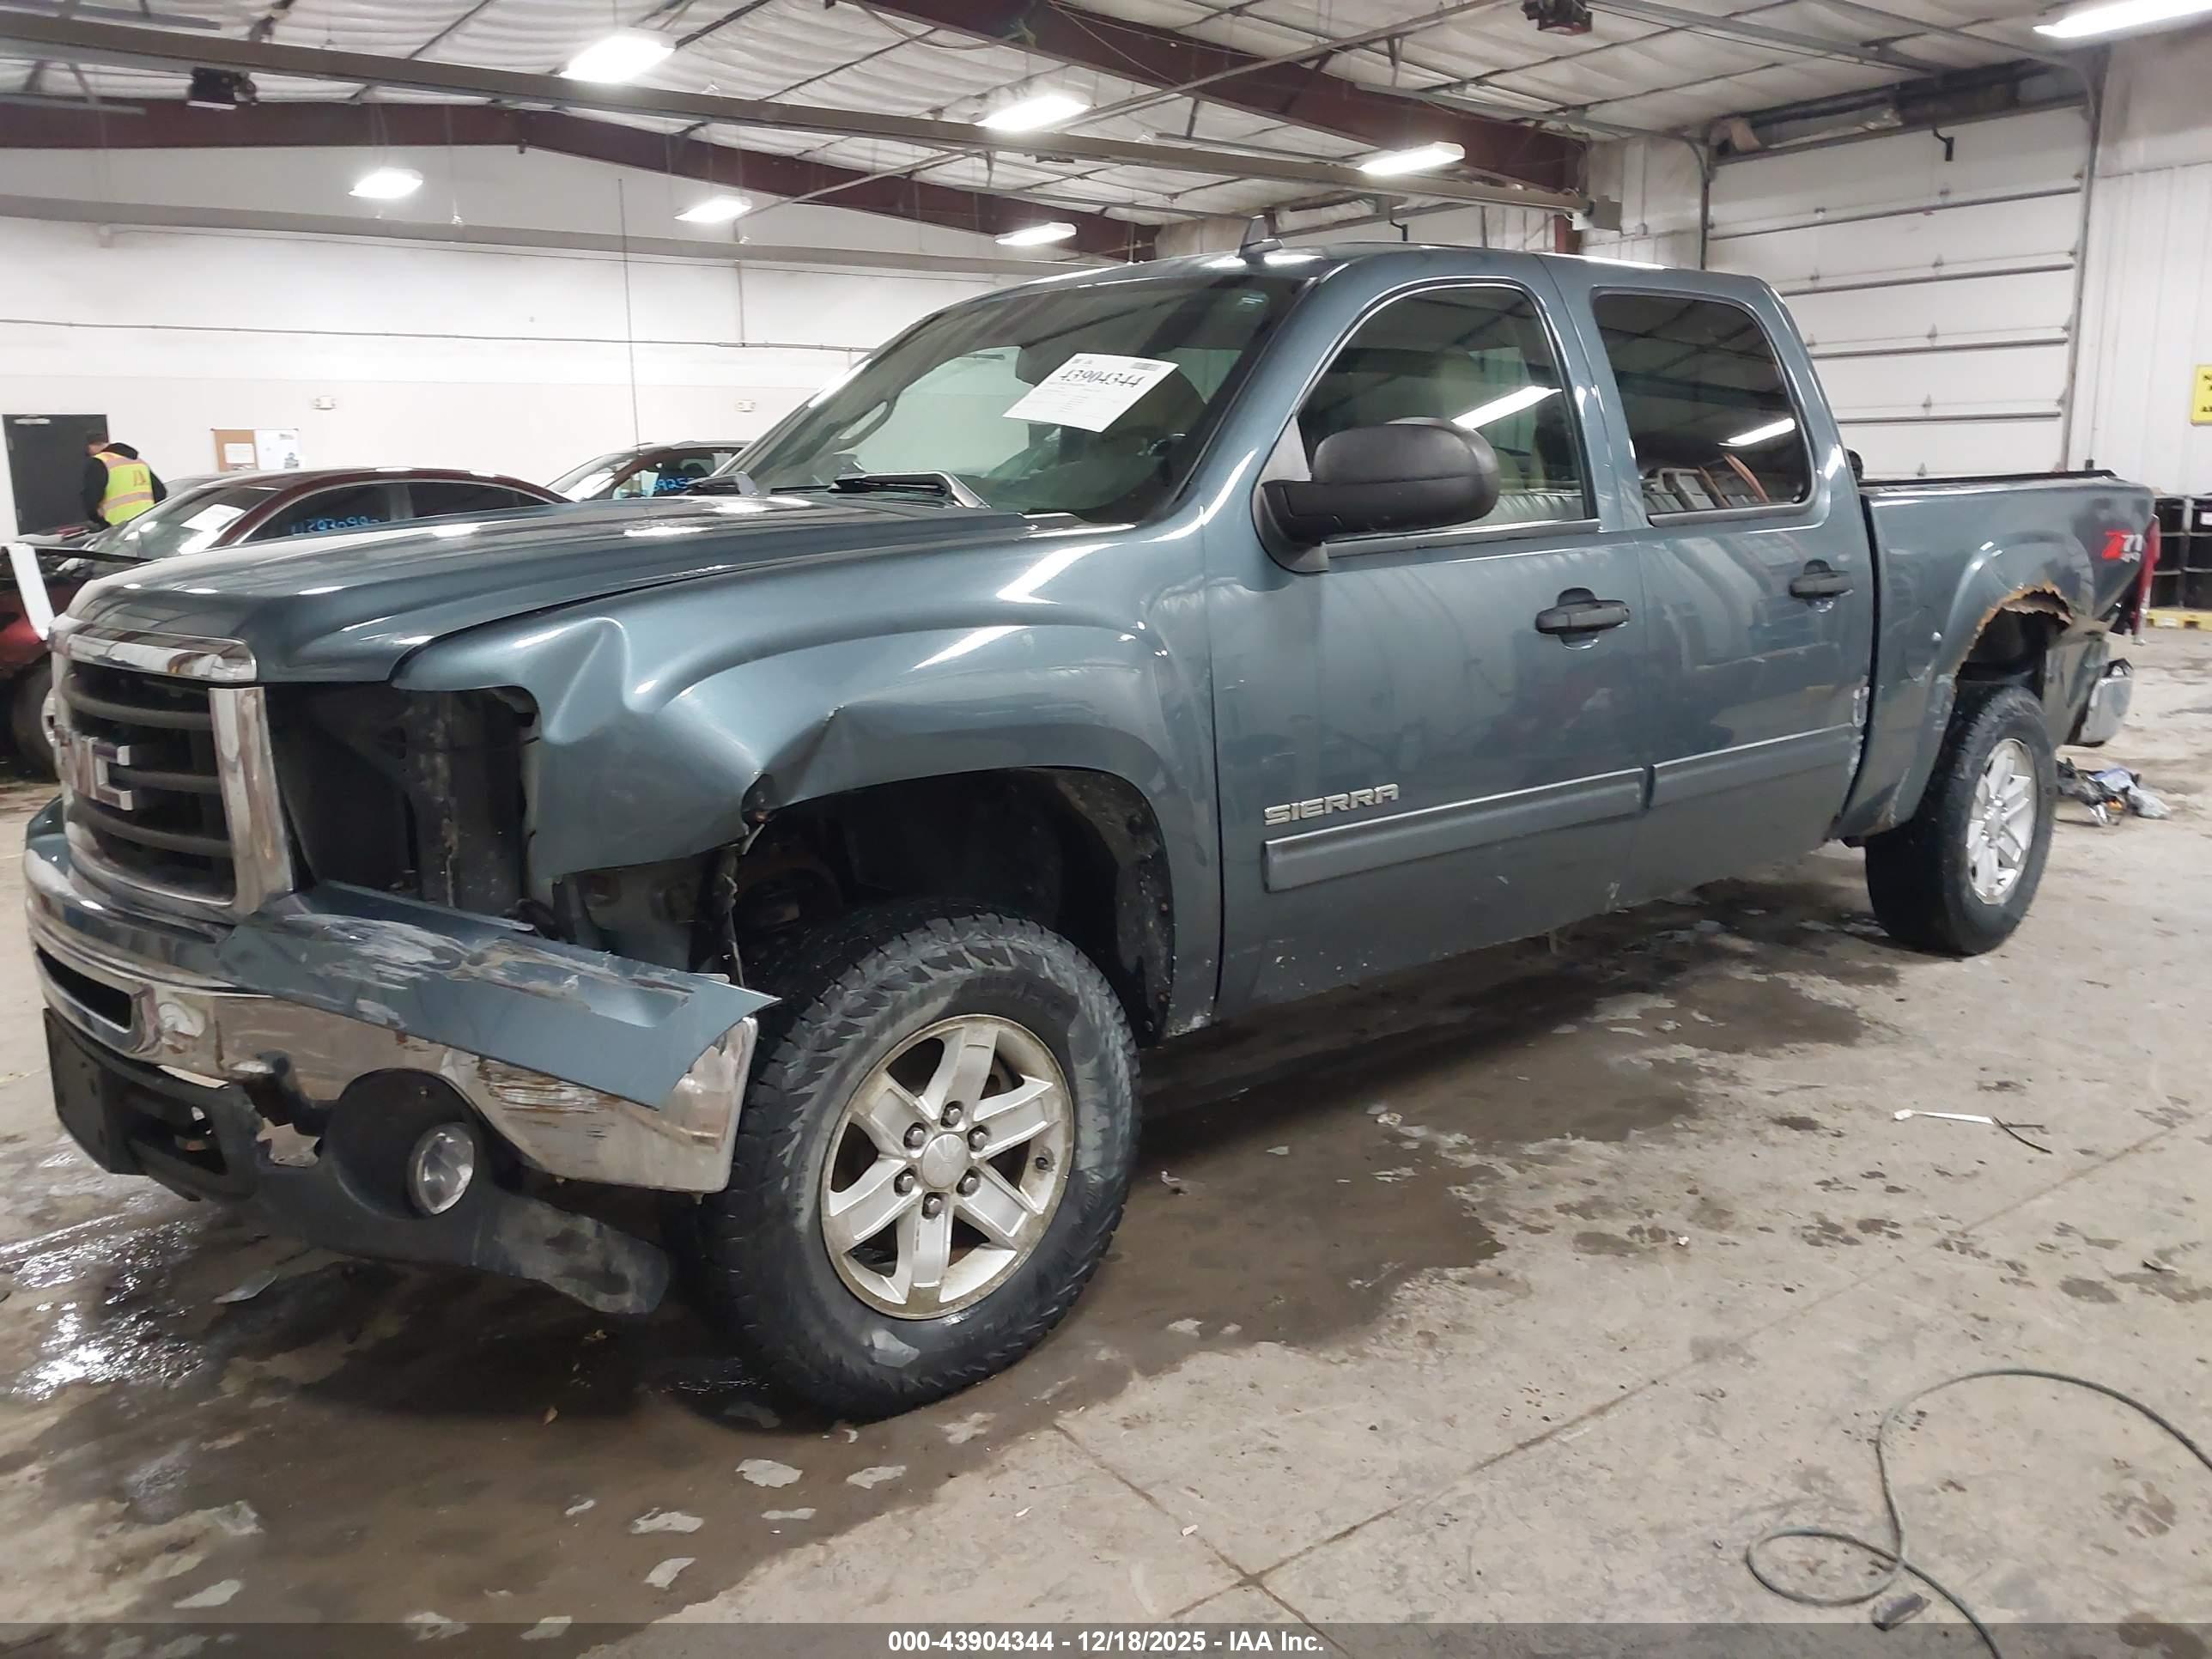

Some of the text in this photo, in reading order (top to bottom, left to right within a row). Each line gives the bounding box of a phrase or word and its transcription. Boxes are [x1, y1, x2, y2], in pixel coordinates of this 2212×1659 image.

[1058, 369, 1146, 388] 43904344
[2102, 530, 2143, 560] Z71
[1264, 783, 1400, 826] SIERRA
